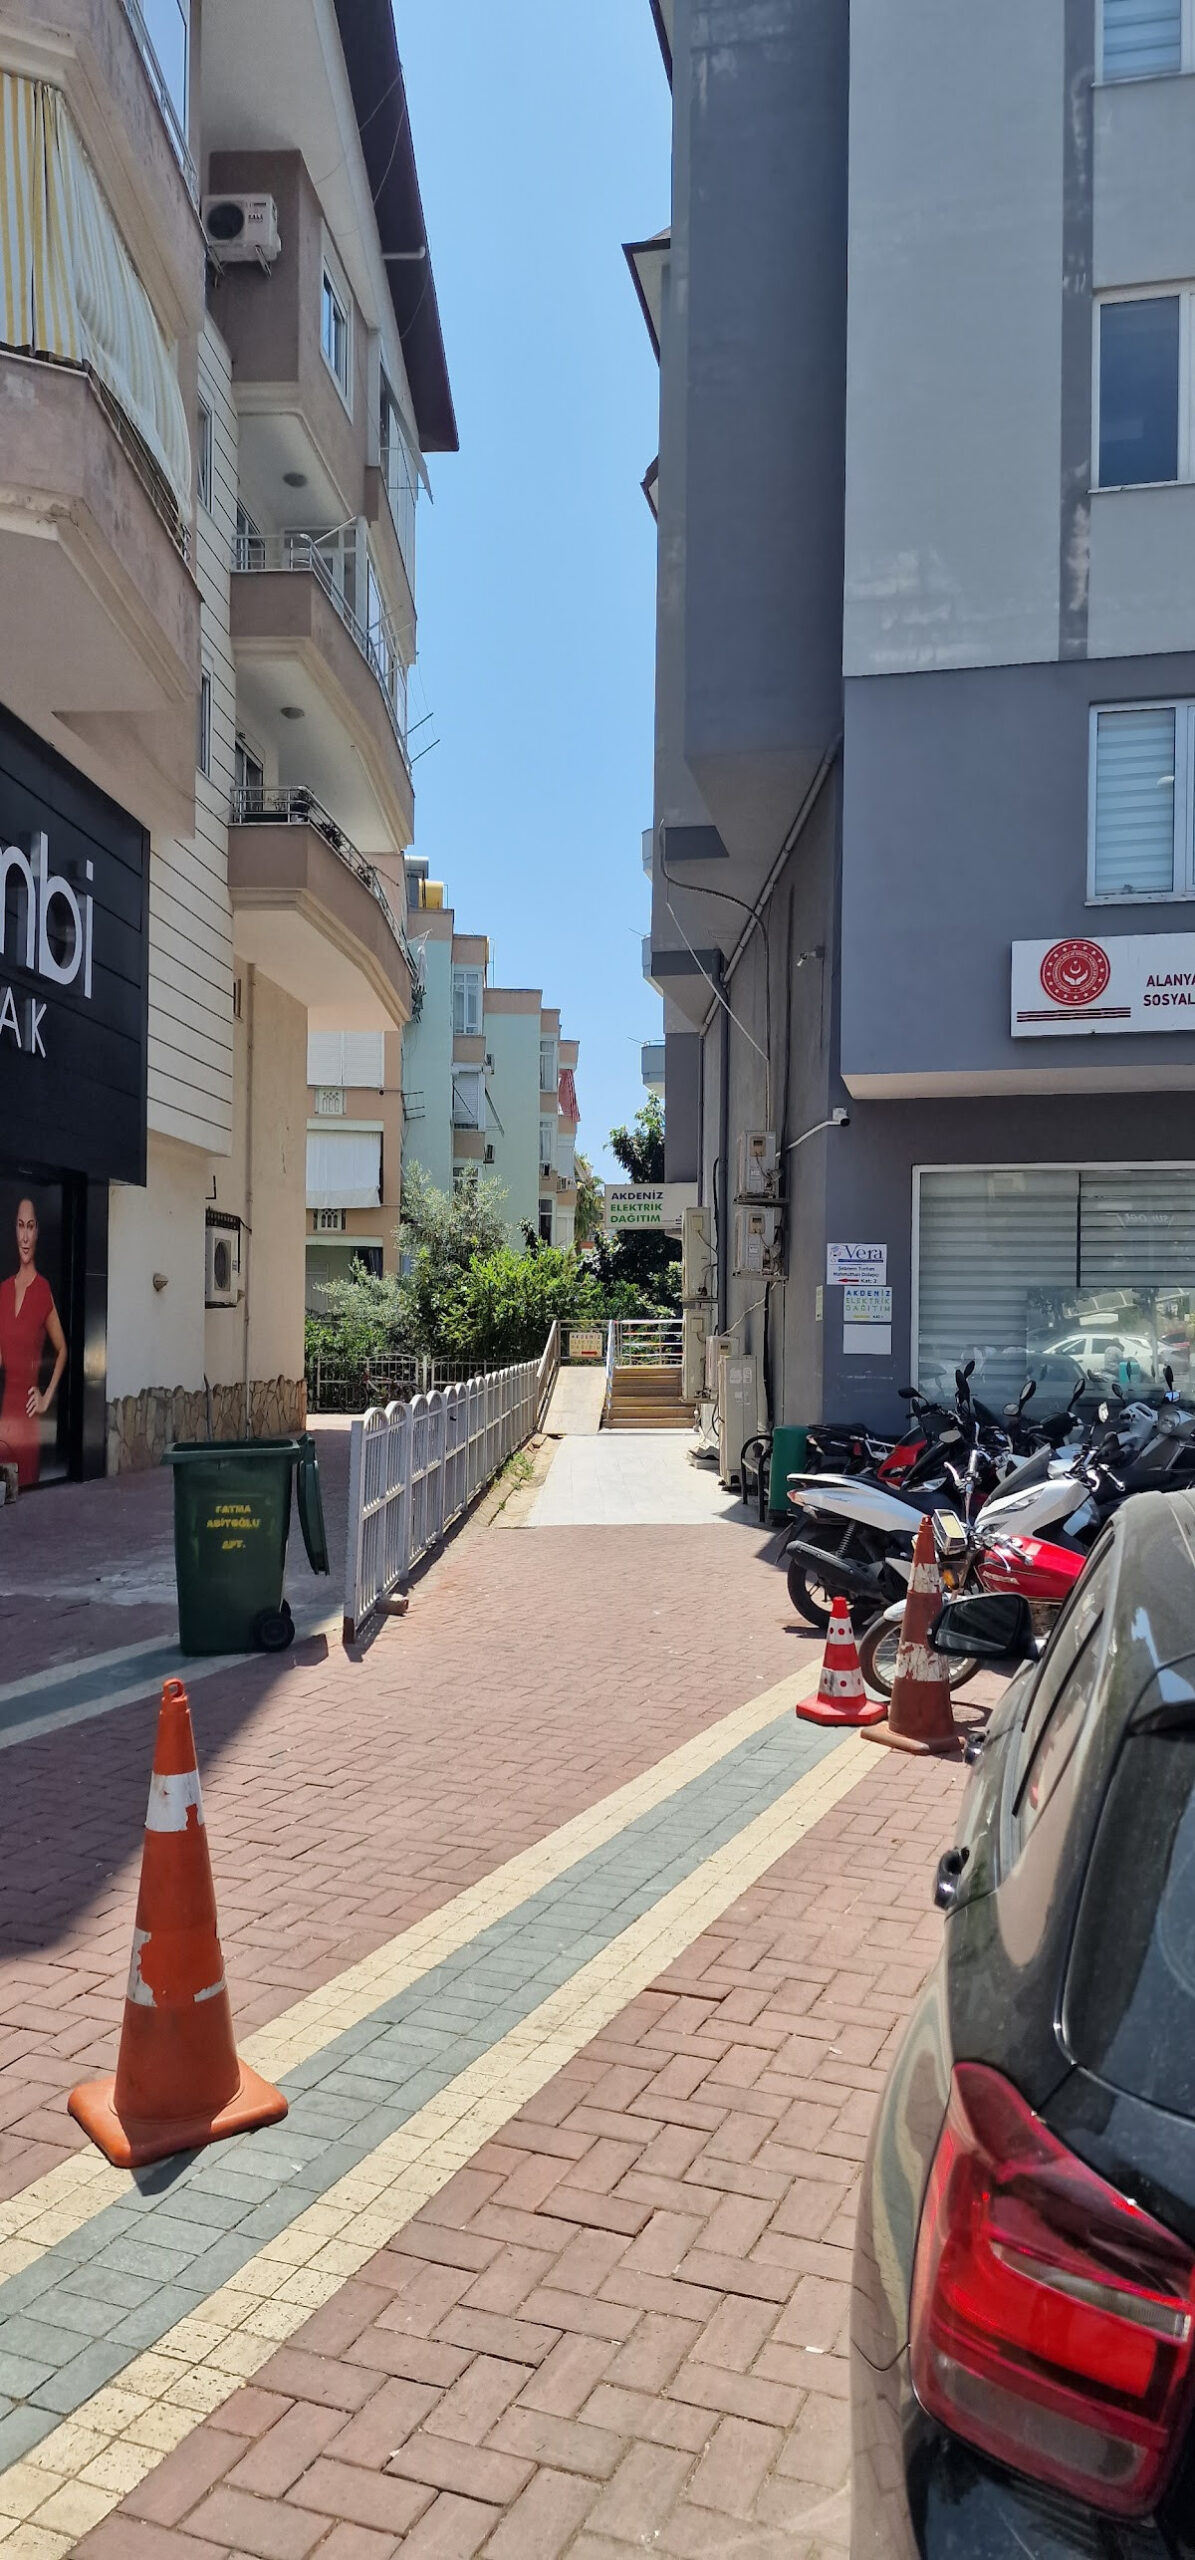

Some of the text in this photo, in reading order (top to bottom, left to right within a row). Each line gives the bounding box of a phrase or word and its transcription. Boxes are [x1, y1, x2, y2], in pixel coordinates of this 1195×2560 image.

[1143, 992, 1195, 1006] SOSYAL
[611, 1189, 664, 1200] AKDENİZ
[610, 1202, 663, 1212] ELEKTRİK
[610, 1213, 661, 1223] DAĞITIM
[842, 1245, 882, 1260] Vera
[846, 1289, 891, 1297] AKDENİZ
